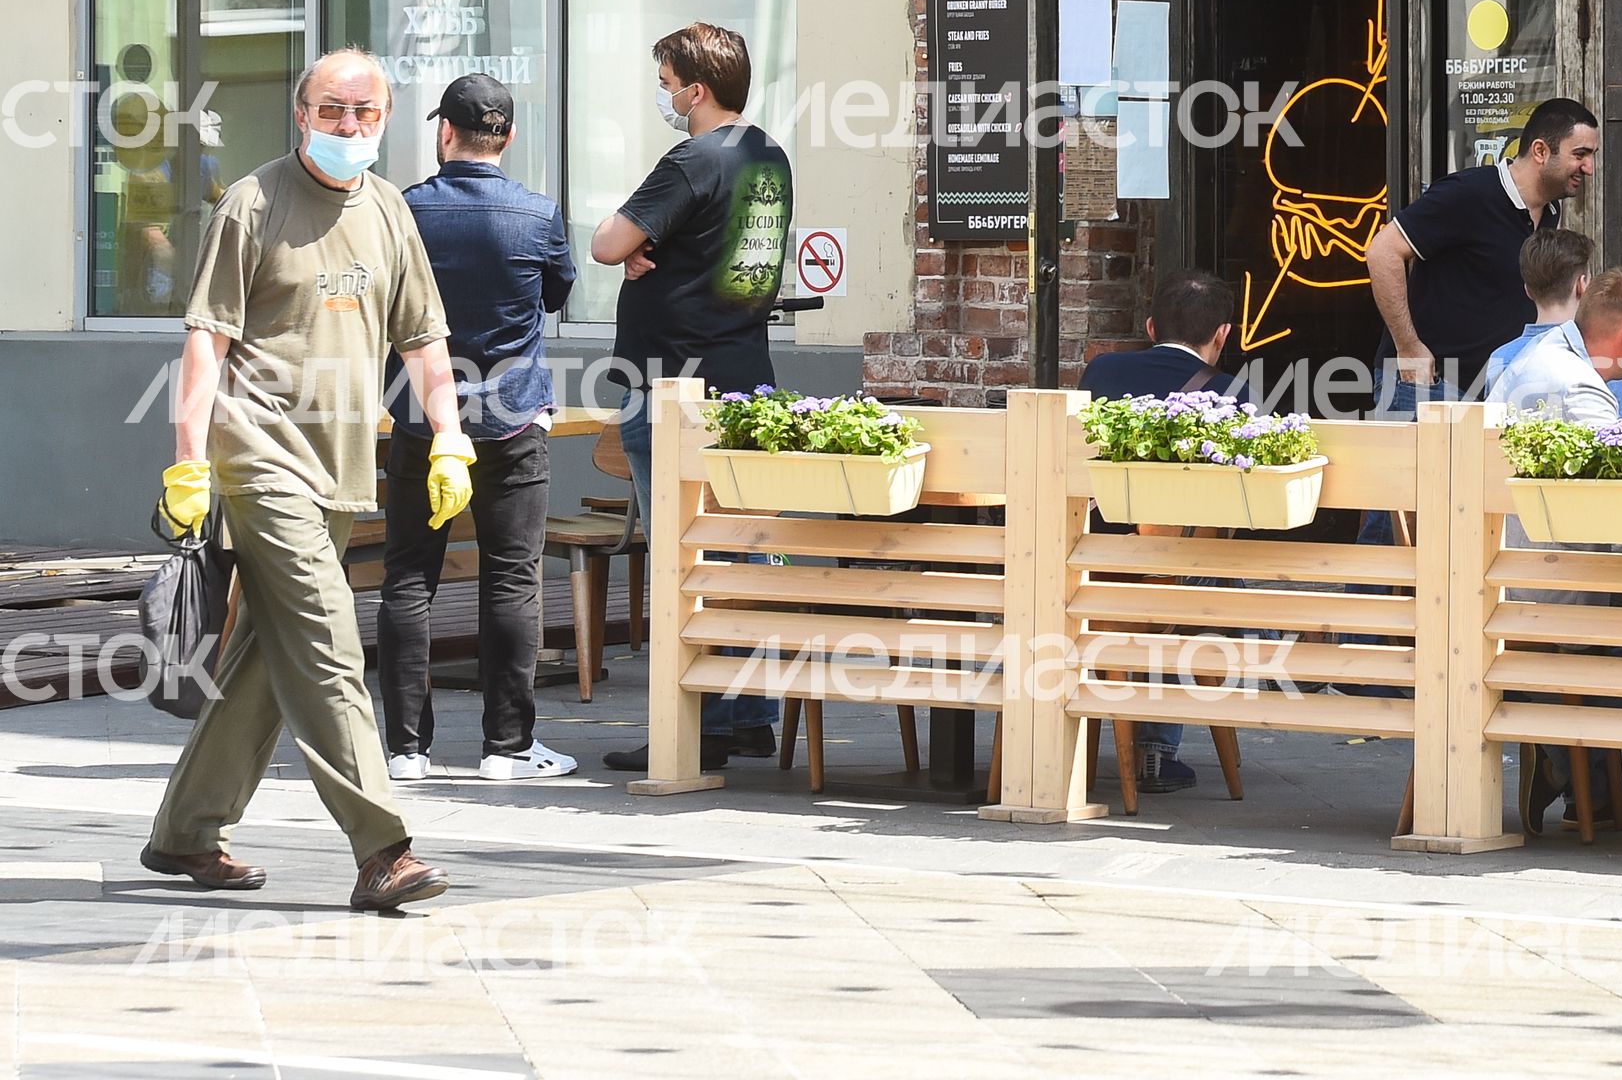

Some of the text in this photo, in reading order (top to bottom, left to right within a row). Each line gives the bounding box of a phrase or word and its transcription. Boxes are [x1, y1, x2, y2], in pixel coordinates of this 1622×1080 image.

[947, 30, 990, 41] STEAK AND FRIES
[948, 62, 963, 72] FRIES
[1445, 58, 1528, 75] ББ&БУРГЕРС
[1458, 80, 1516, 90] РЕЖИМ РАБОТЫ
[981, 93, 1002, 103] CHICKEN
[1459, 92, 1515, 104] 11.00-23.30
[1465, 108, 1509, 116] БЕЗ ПЕРЕРЫВА
[1464, 116, 1510, 125] БЕЗ ВЫХОДНЫХ
[738, 214, 774, 229] LUCID
[968, 215, 1029, 229] ББ&БУРГЕР
